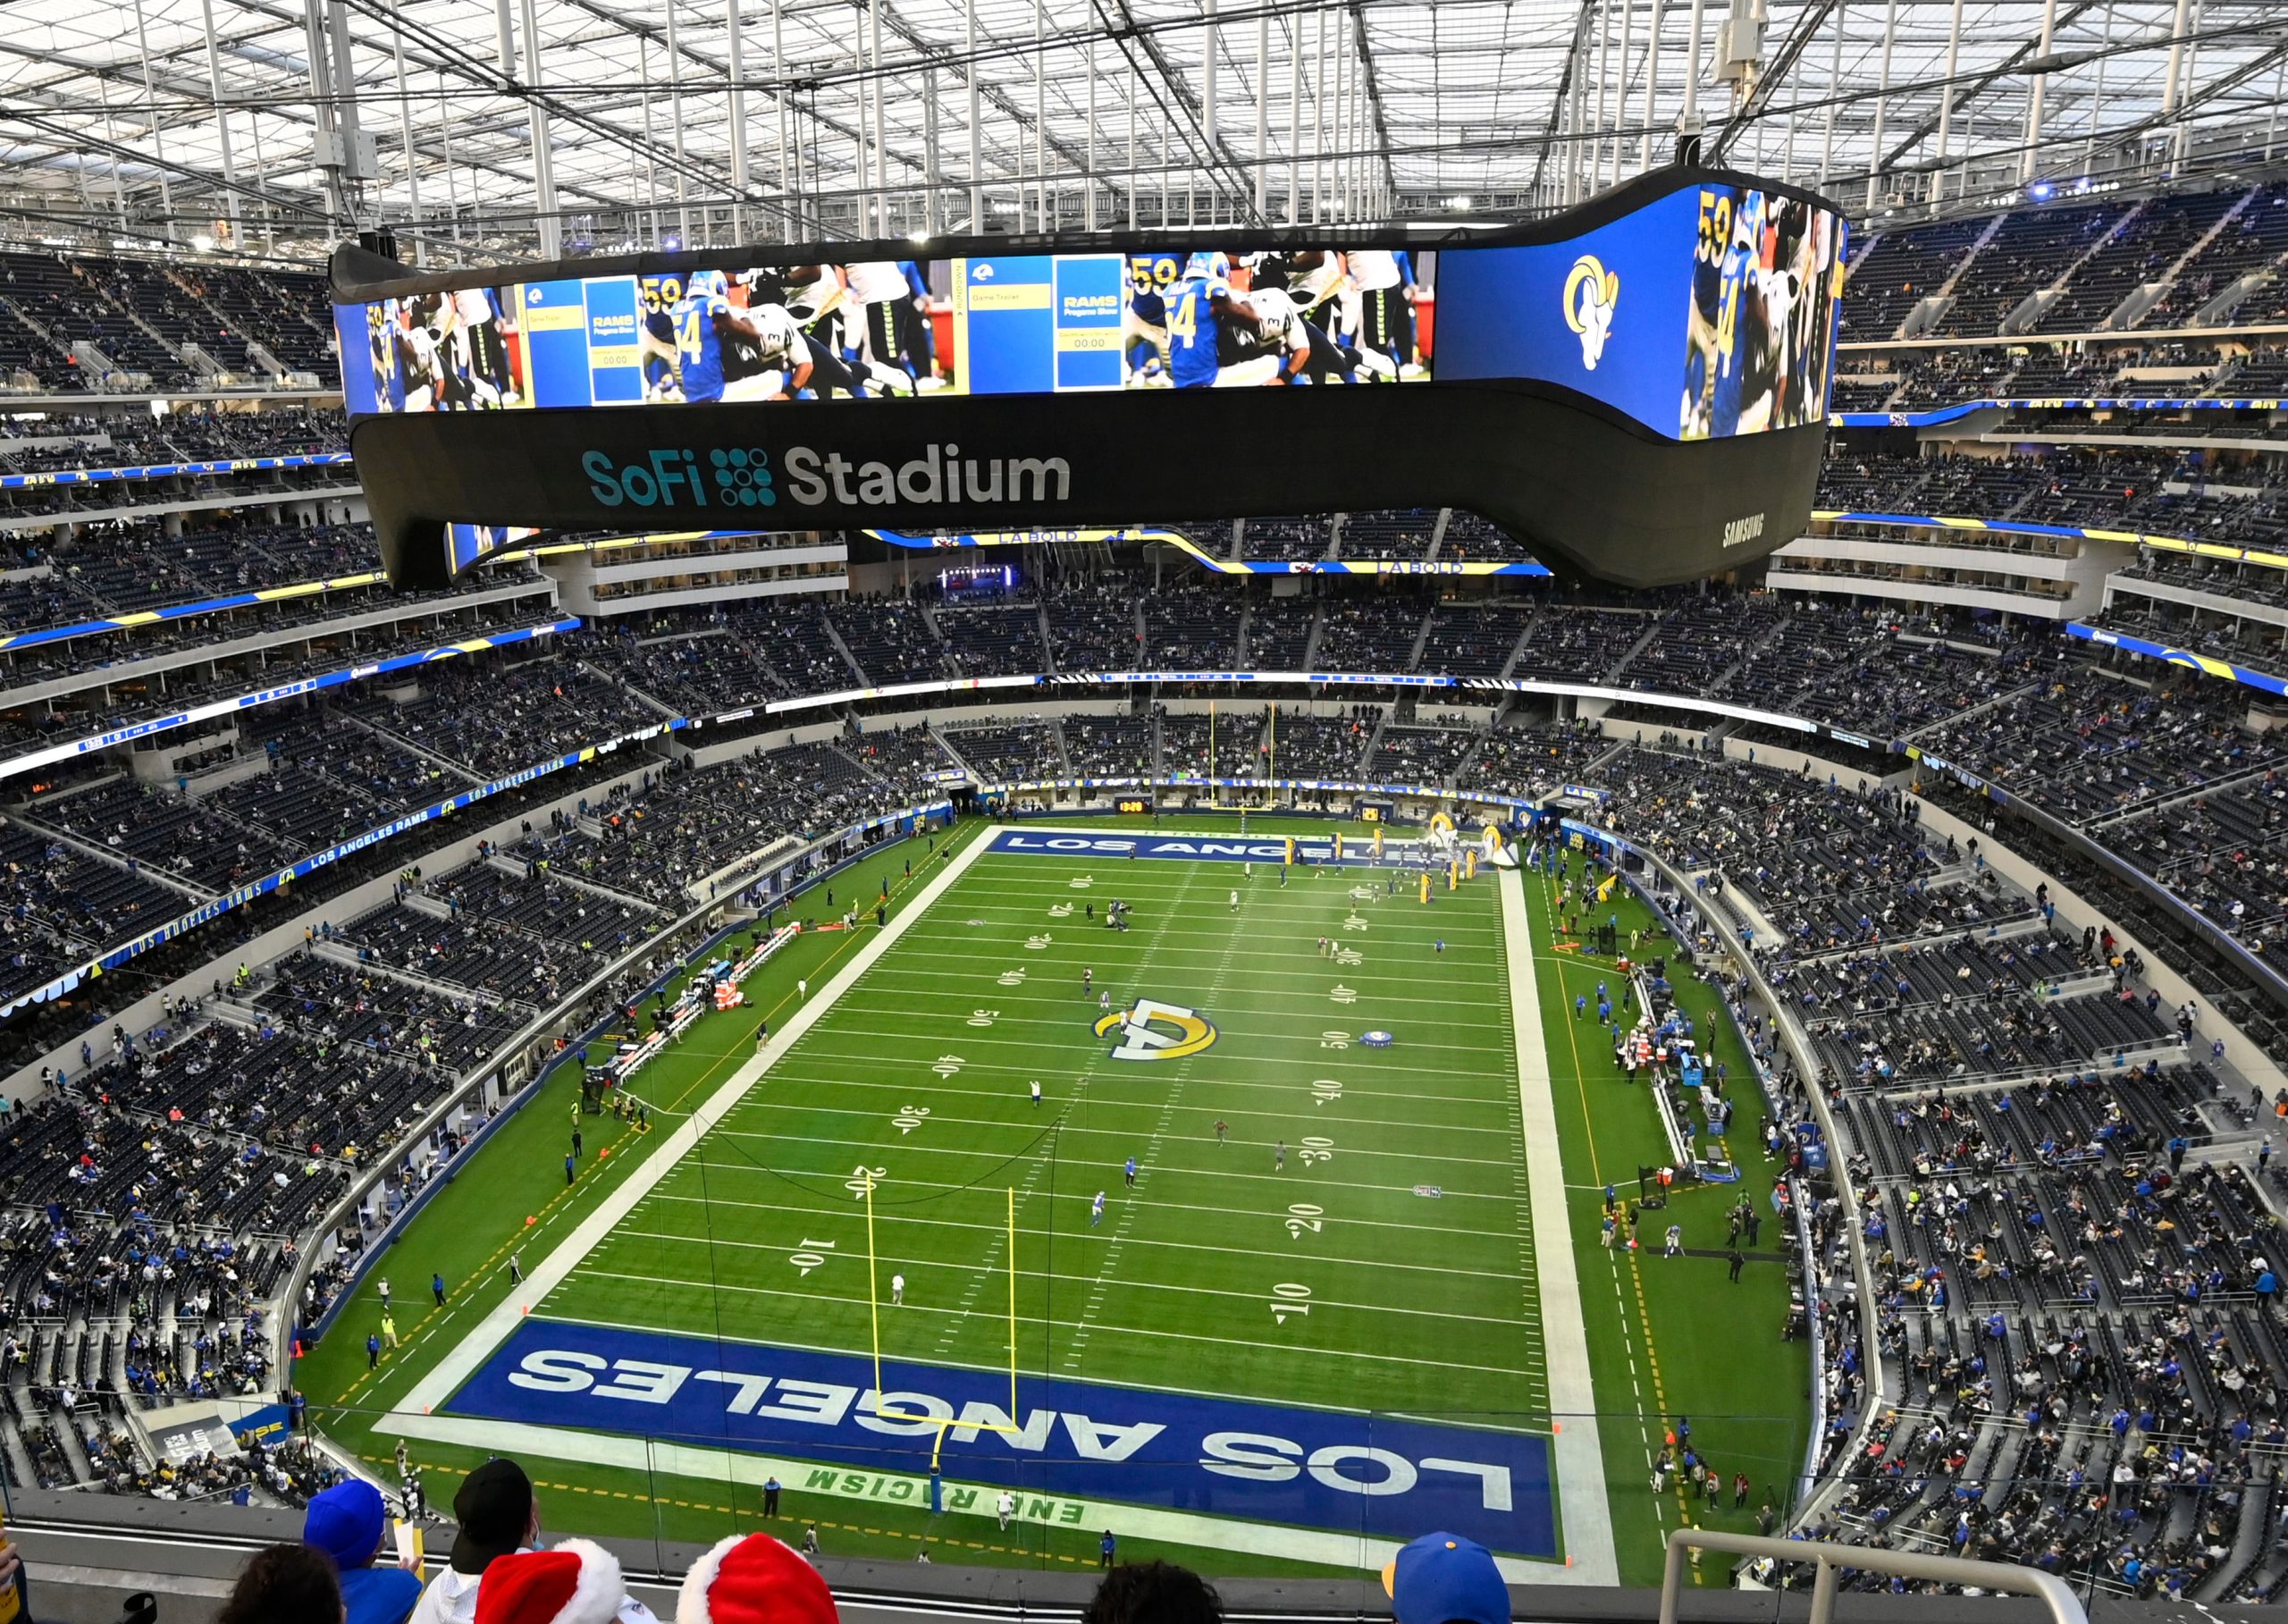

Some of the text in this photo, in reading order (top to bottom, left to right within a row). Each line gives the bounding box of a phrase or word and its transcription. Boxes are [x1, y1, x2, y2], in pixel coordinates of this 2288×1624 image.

[1131, 258, 1177, 297] 59
[642, 279, 681, 316] 59
[1064, 296, 1118, 307] RAMS
[1064, 307, 1118, 317] Pregame Show
[593, 315, 634, 328] RAMS
[593, 326, 635, 336] Pregame Show
[1074, 338, 1105, 348] 00:00
[582, 443, 1071, 507] SoFi Stadium
[998, 532, 1078, 544] LA BOLD
[1723, 512, 1764, 549] SAMSUNG
[1376, 562, 1463, 574] LA BOLD
[1566, 787, 1579, 796] LA
[310, 811, 428, 871] LOS ANGELES RAMS
[1007, 837, 1138, 850] LOS
[1342, 918, 1368, 931] 20
[1023, 935, 1053, 949] 30
[1336, 951, 1363, 965] 30
[997, 970, 1027, 986] 40
[1329, 989, 1357, 1004] 40
[966, 1009, 1001, 1027] 50
[1319, 1031, 1351, 1050] 50
[931, 1054, 966, 1073] 40
[1310, 1079, 1343, 1100] 40
[891, 1105, 930, 1128] 30
[1299, 1136, 1334, 1161] 30
[845, 1165, 887, 1191] 20
[1285, 1203, 1324, 1233] 20
[789, 1238, 836, 1266] 10
[1269, 1283, 1311, 1316] 10
[508, 1350, 1513, 1511] LOS ANGELES
